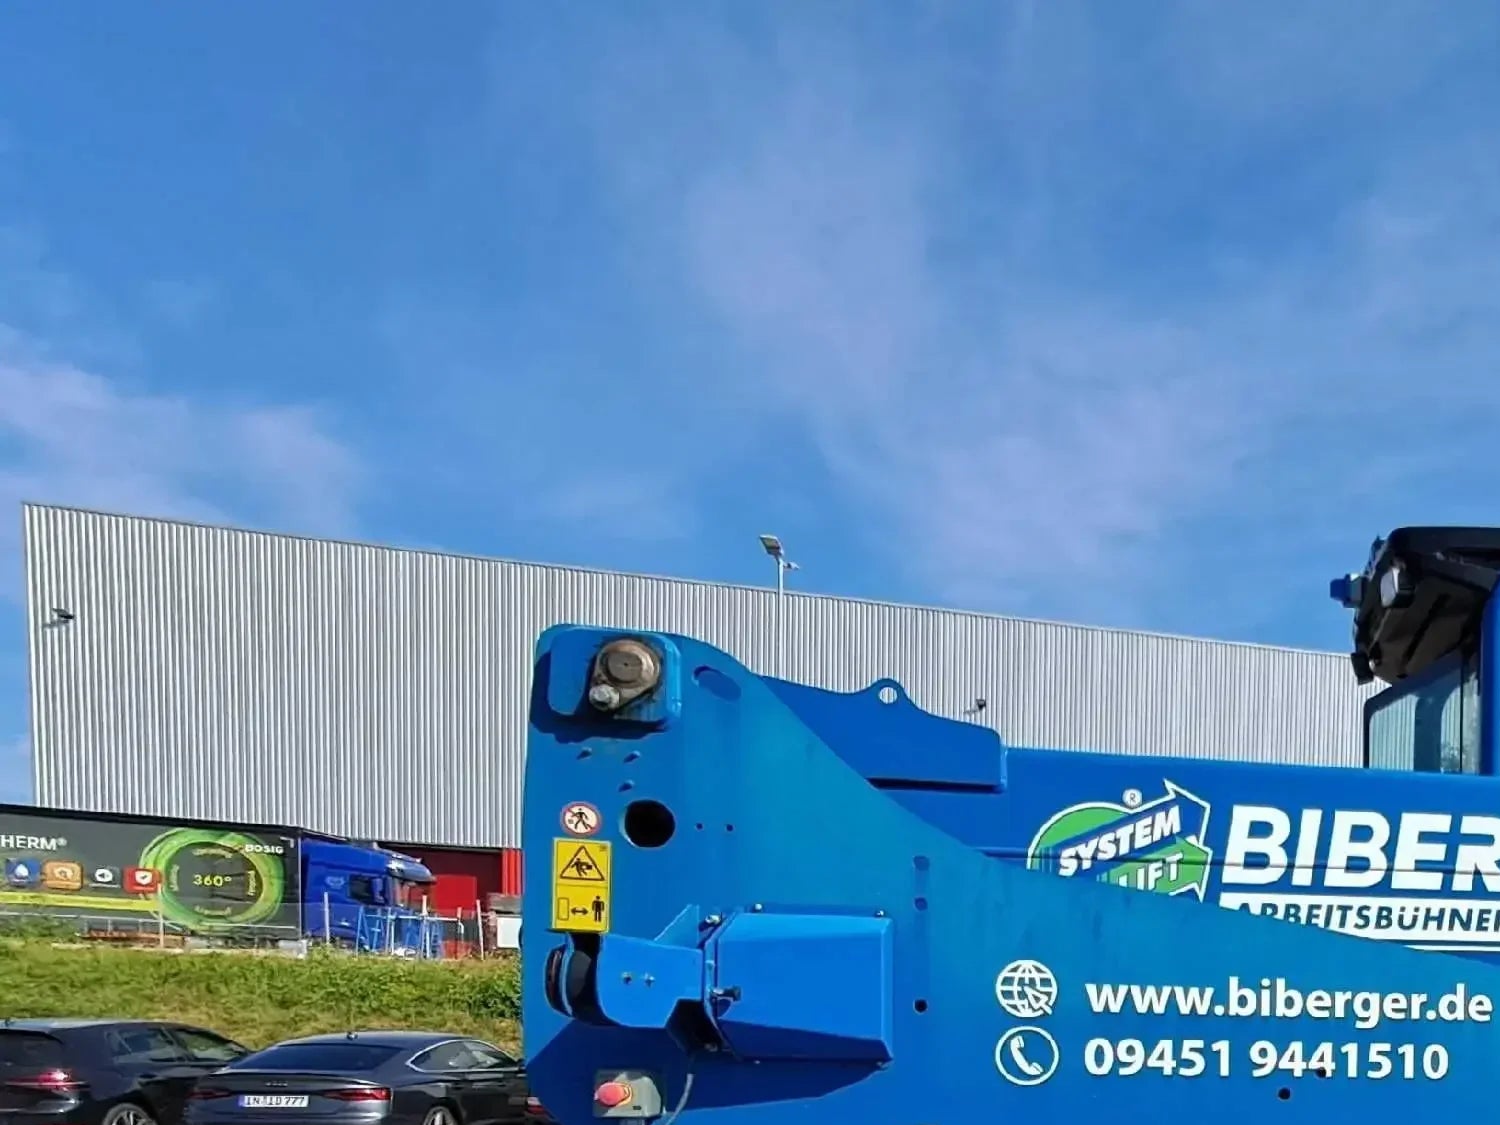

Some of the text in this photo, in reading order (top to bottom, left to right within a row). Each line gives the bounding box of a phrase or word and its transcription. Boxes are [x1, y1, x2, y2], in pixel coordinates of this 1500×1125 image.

[1058, 804, 1181, 877] SYSTEM
[1086, 977, 1493, 1030] www.biberger.de
[1084, 1038, 1450, 1080] 09451 9441510
